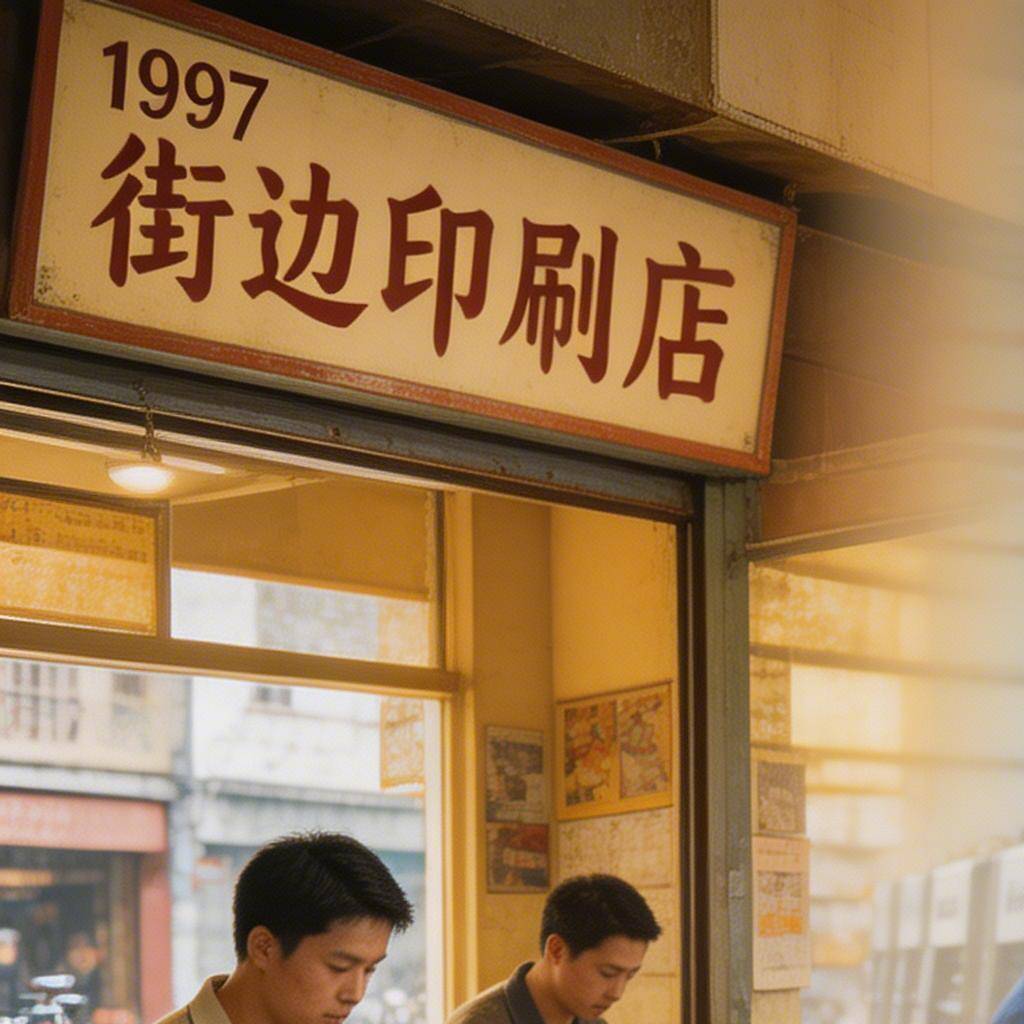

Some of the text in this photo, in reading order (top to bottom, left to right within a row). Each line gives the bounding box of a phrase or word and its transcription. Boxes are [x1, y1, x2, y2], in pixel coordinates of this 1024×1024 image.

[102, 40, 269, 141] 1997
[90, 132, 736, 403] 街边印刷店
